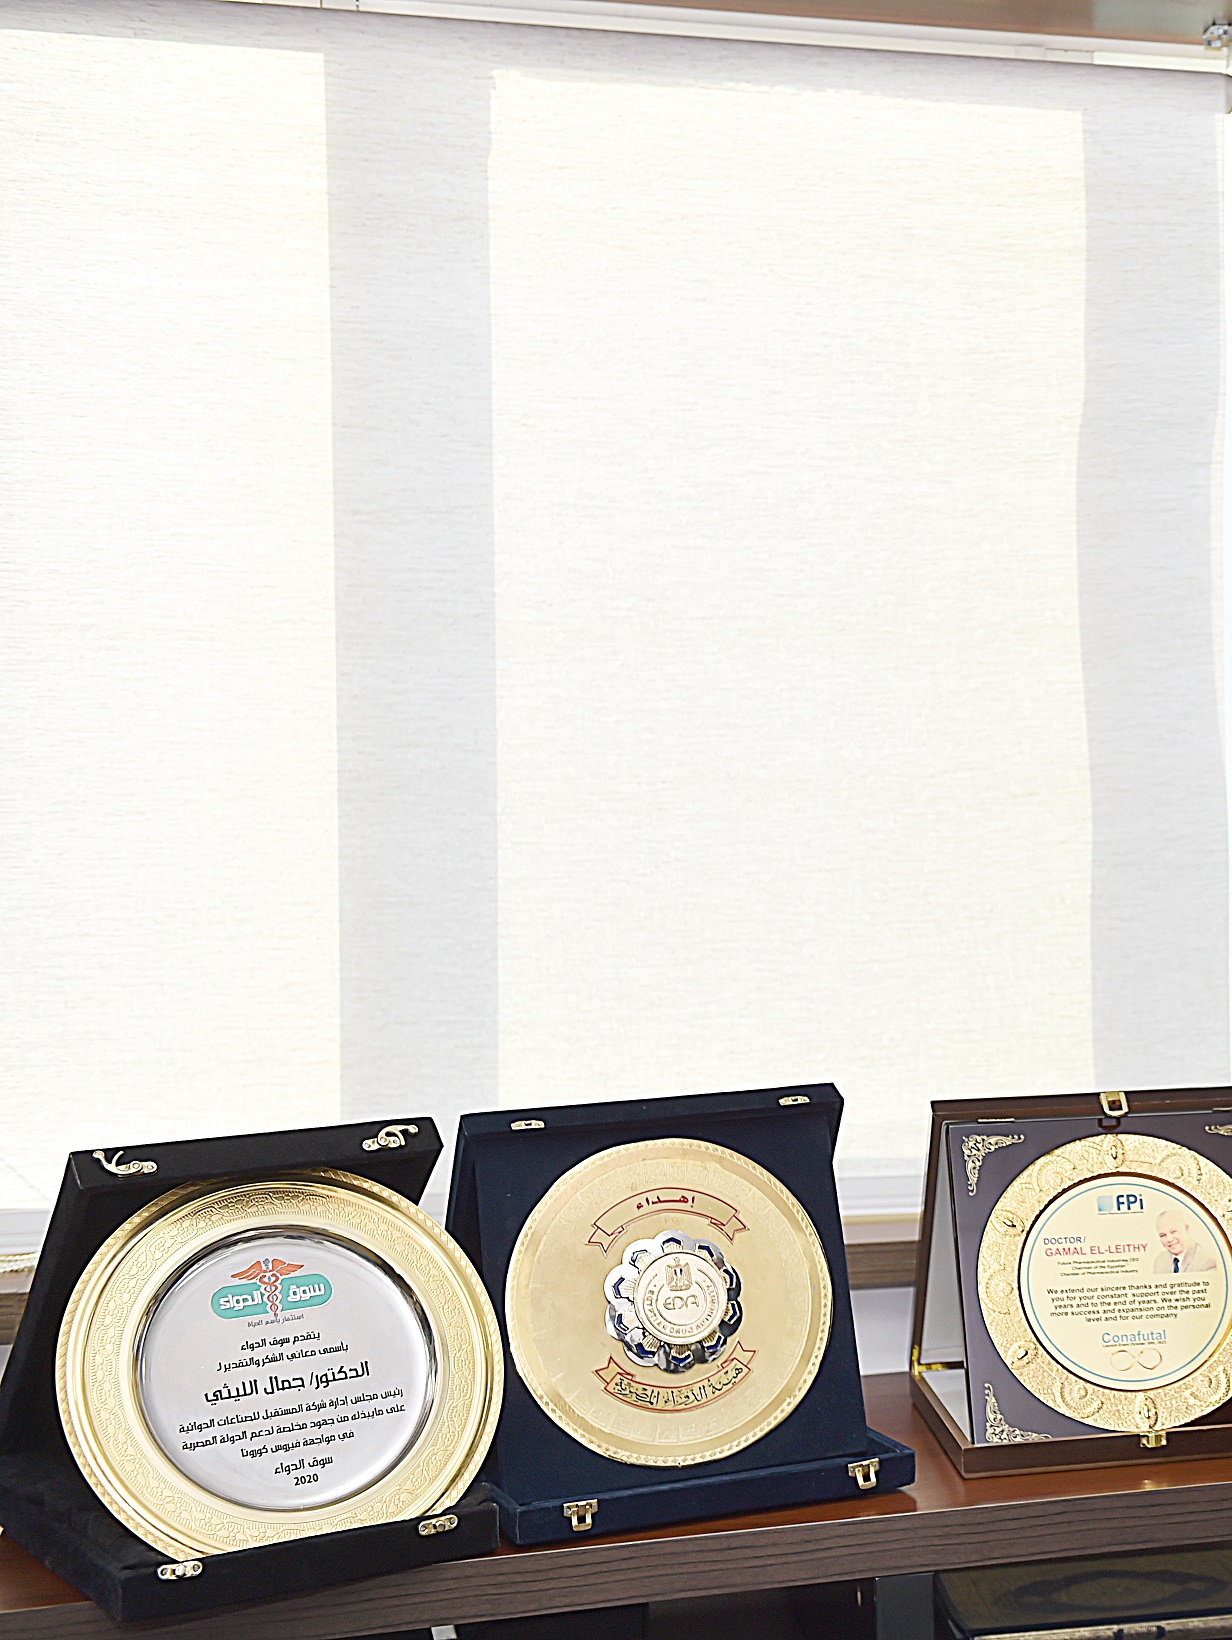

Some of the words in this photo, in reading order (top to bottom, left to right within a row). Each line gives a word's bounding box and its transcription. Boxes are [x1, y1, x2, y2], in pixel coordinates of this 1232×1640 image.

[1116, 1194, 1144, 1211] FPi
[1045, 1246, 1086, 1257] GAMAL
[1090, 1243, 1148, 1254] EL-LEITHY
[288, 1284, 325, 1302] سوق
[219, 1290, 262, 1311] الدواء
[669, 1326, 695, 1334] DRUG
[1102, 1329, 1166, 1343] Conafutal
[241, 1338, 266, 1352] الدواء
[269, 1337, 290, 1348] سوق
[293, 1331, 320, 1345] يتقدم
[262, 1352, 284, 1367] الشكر
[286, 1349, 316, 1362] معاني
[224, 1357, 260, 1373] والتقدير
[264, 1376, 305, 1395] جمال
[708, 1364, 743, 1394] هيئة
[204, 1379, 259, 1406] الليثي
[350, 1393, 378, 1404] مجلس
[613, 1378, 660, 1406] المصرية
[662, 1384, 708, 1406] الدواء
[305, 1399, 327, 1412] شركة
[329, 1396, 348, 1409] إدارة
[386, 1404, 406, 1414] على
[217, 1411, 260, 1427] للصناعات
[262, 1404, 304, 1420] المستقبل
[337, 1415, 350, 1423] من
[179, 1419, 215, 1434] الدوائية
[276, 1422, 308, 1434] مخلصة
[310, 1418, 335, 1429] جهود
[220, 1431, 248, 1444] الدولة
[250, 1426, 274, 1441] لدعم
[303, 1434, 336, 1446] مواجهة
[338, 1430, 355, 1442] في
[182, 1436, 218, 1451] المصرية
[270, 1439, 301, 1452] فيروس
[241, 1445, 268, 1458] كورونا
[274, 1459, 305, 1475] الدواء
[308, 1456, 333, 1469] سوق
[294, 1473, 319, 1486] 2020
